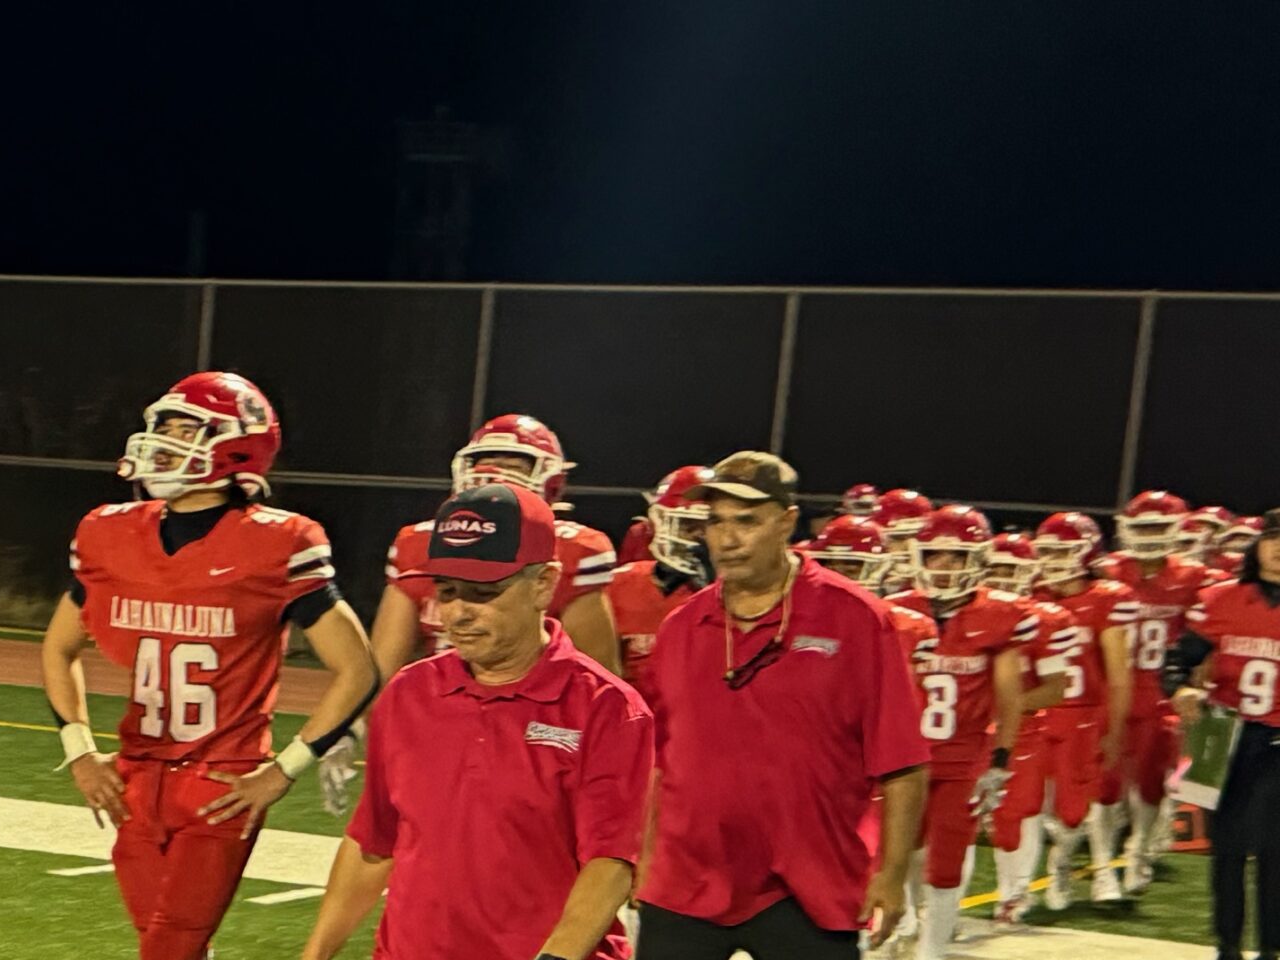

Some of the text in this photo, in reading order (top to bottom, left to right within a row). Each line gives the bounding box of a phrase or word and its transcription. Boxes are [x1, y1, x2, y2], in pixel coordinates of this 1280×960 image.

[437, 519, 497, 534] LUNAS
[110, 596, 238, 637] LAHAINALUNA
[134, 637, 218, 742] 46
[921, 673, 958, 740] 8
[1238, 659, 1278, 716] 9
